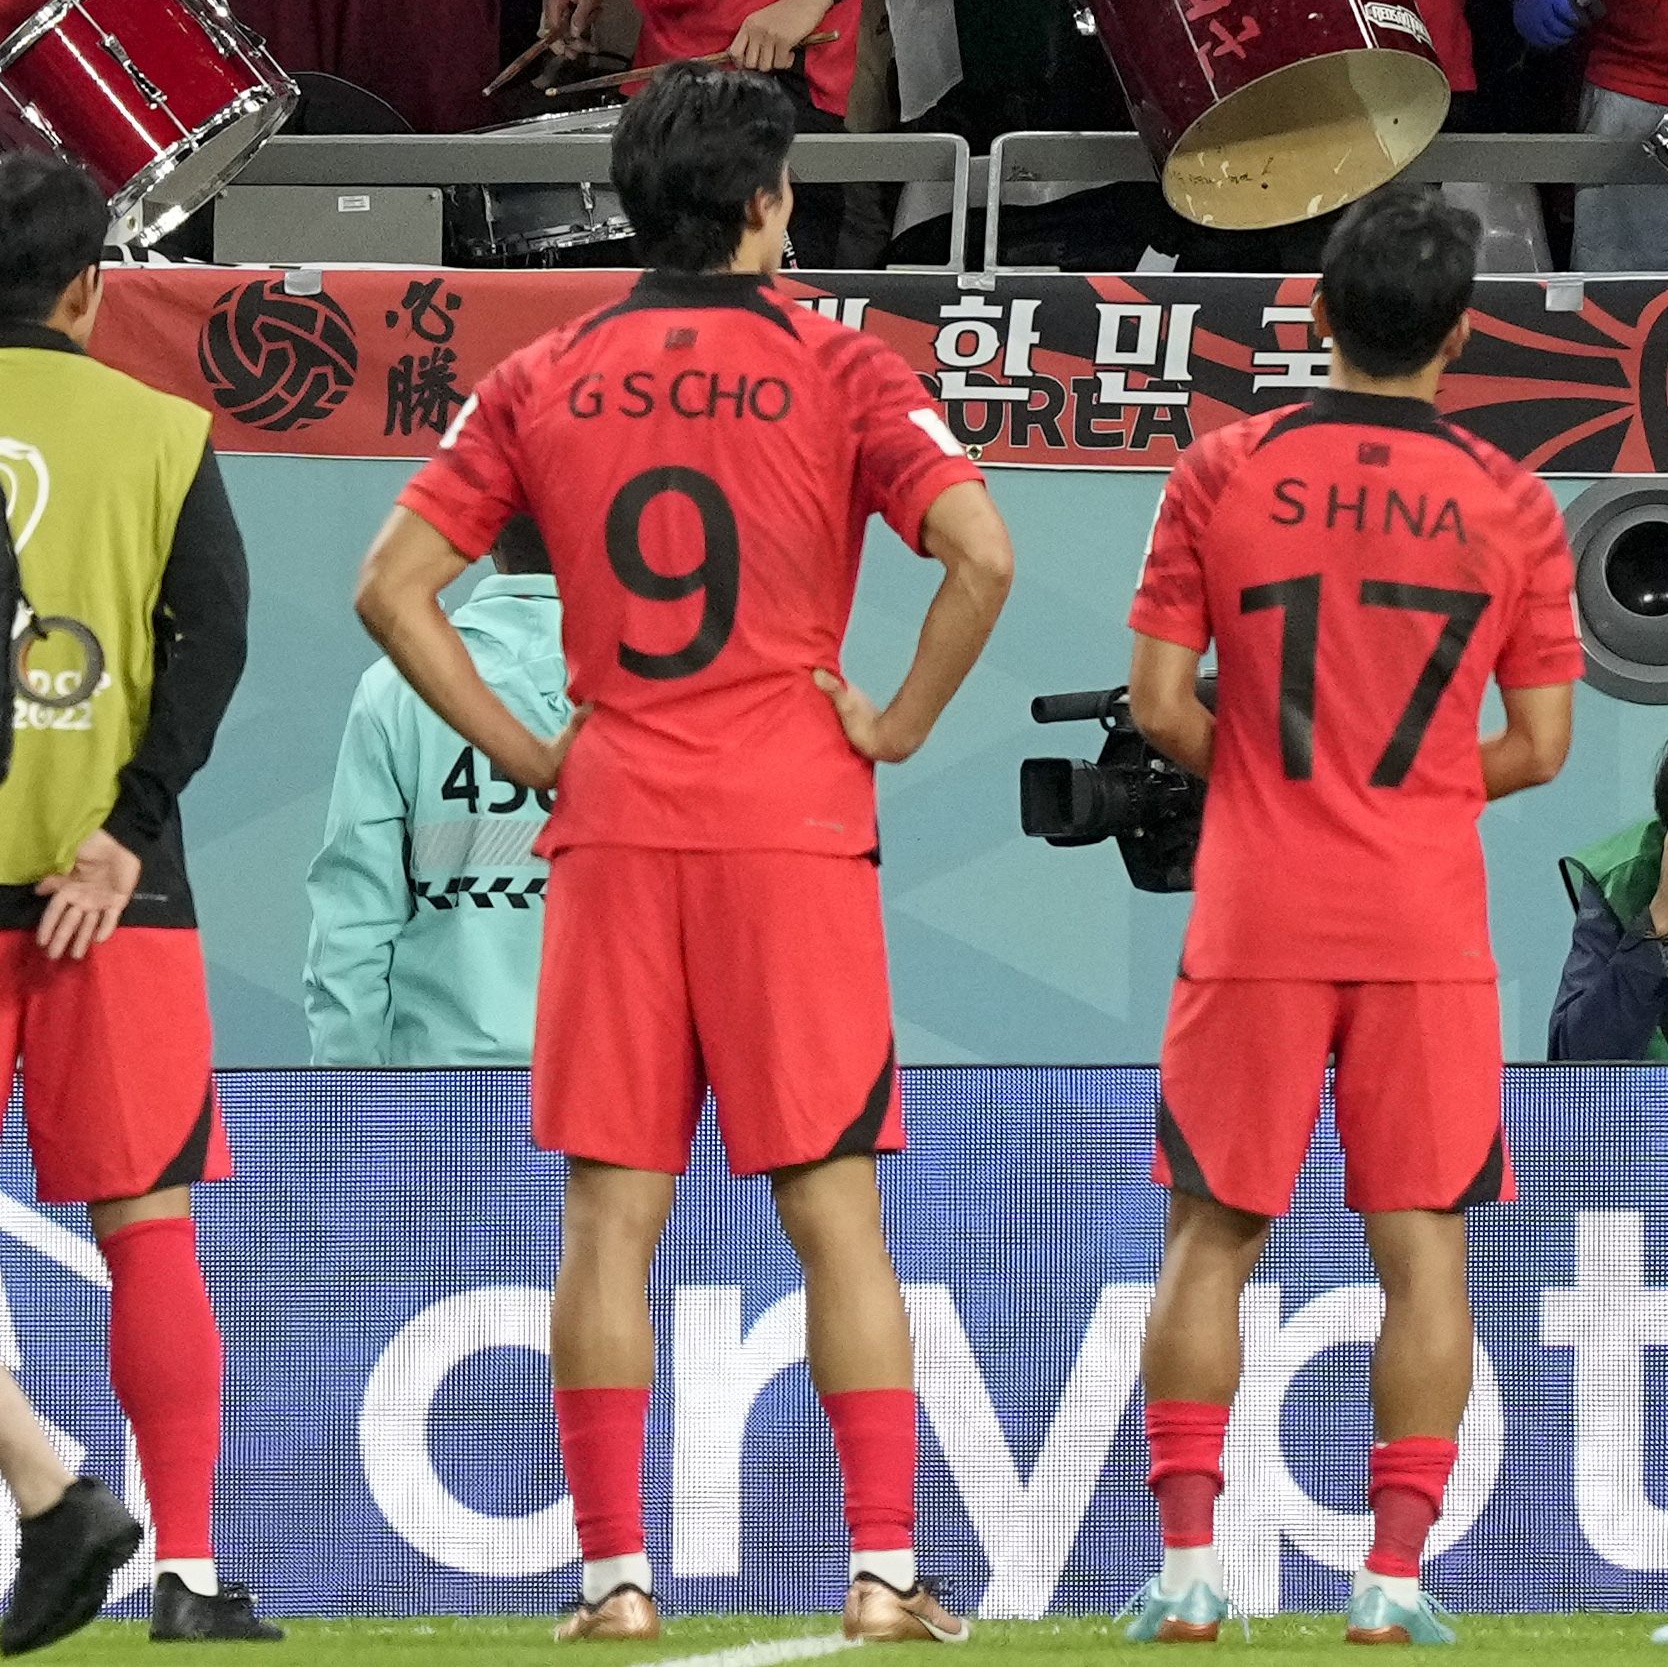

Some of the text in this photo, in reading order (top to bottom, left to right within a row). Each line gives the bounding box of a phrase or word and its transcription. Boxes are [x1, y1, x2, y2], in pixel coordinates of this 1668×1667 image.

[568, 369, 793, 422] G S CHO
[604, 464, 741, 681] 9
[1270, 476, 1469, 547] S H NA
[1239, 572, 1491, 788] 17
